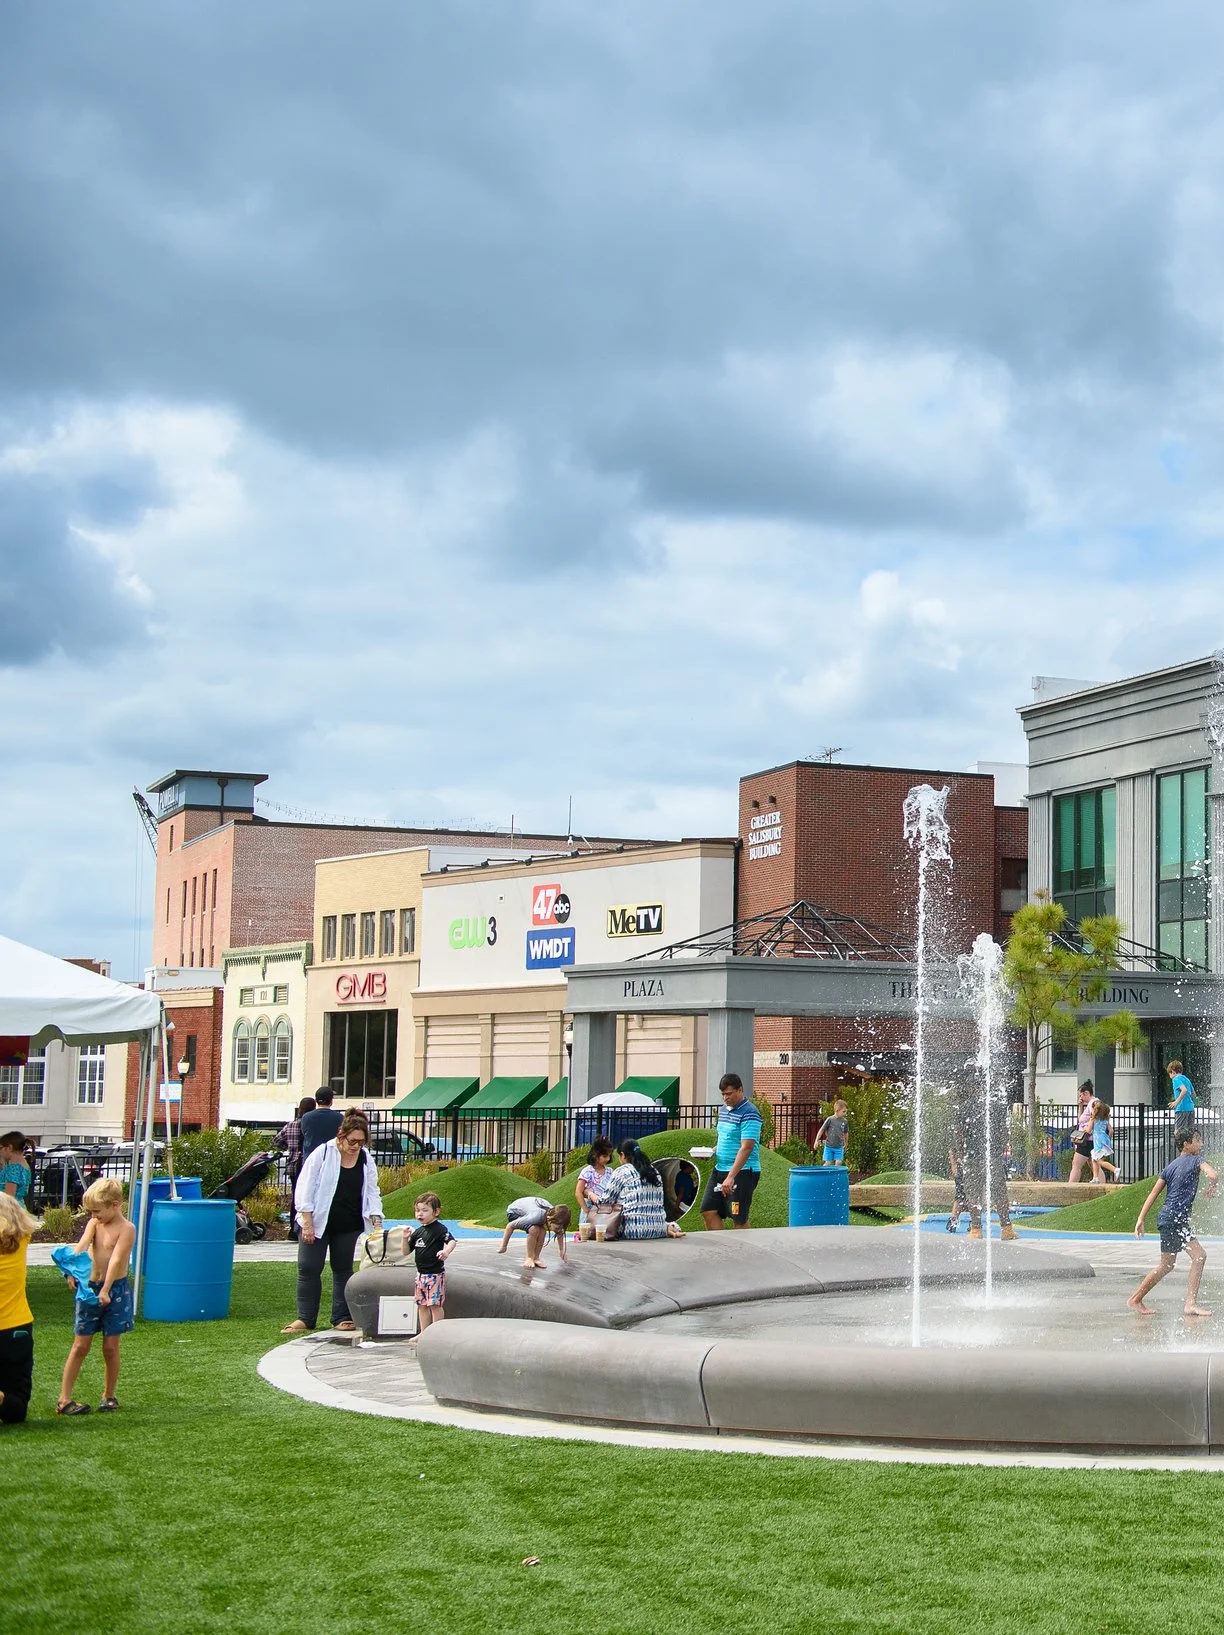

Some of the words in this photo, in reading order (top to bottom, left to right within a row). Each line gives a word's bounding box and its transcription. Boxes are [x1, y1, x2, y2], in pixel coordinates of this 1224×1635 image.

[751, 811, 781, 830] GREATER
[748, 826, 783, 846] SALISBURY
[749, 842, 782, 861] BUILDING
[533, 889, 557, 920] 47
[553, 899, 570, 915] abc
[608, 906, 662, 935] MeTV
[528, 937, 571, 961] WMDT
[335, 972, 387, 1001] GMB
[624, 979, 665, 998] PLAZA
